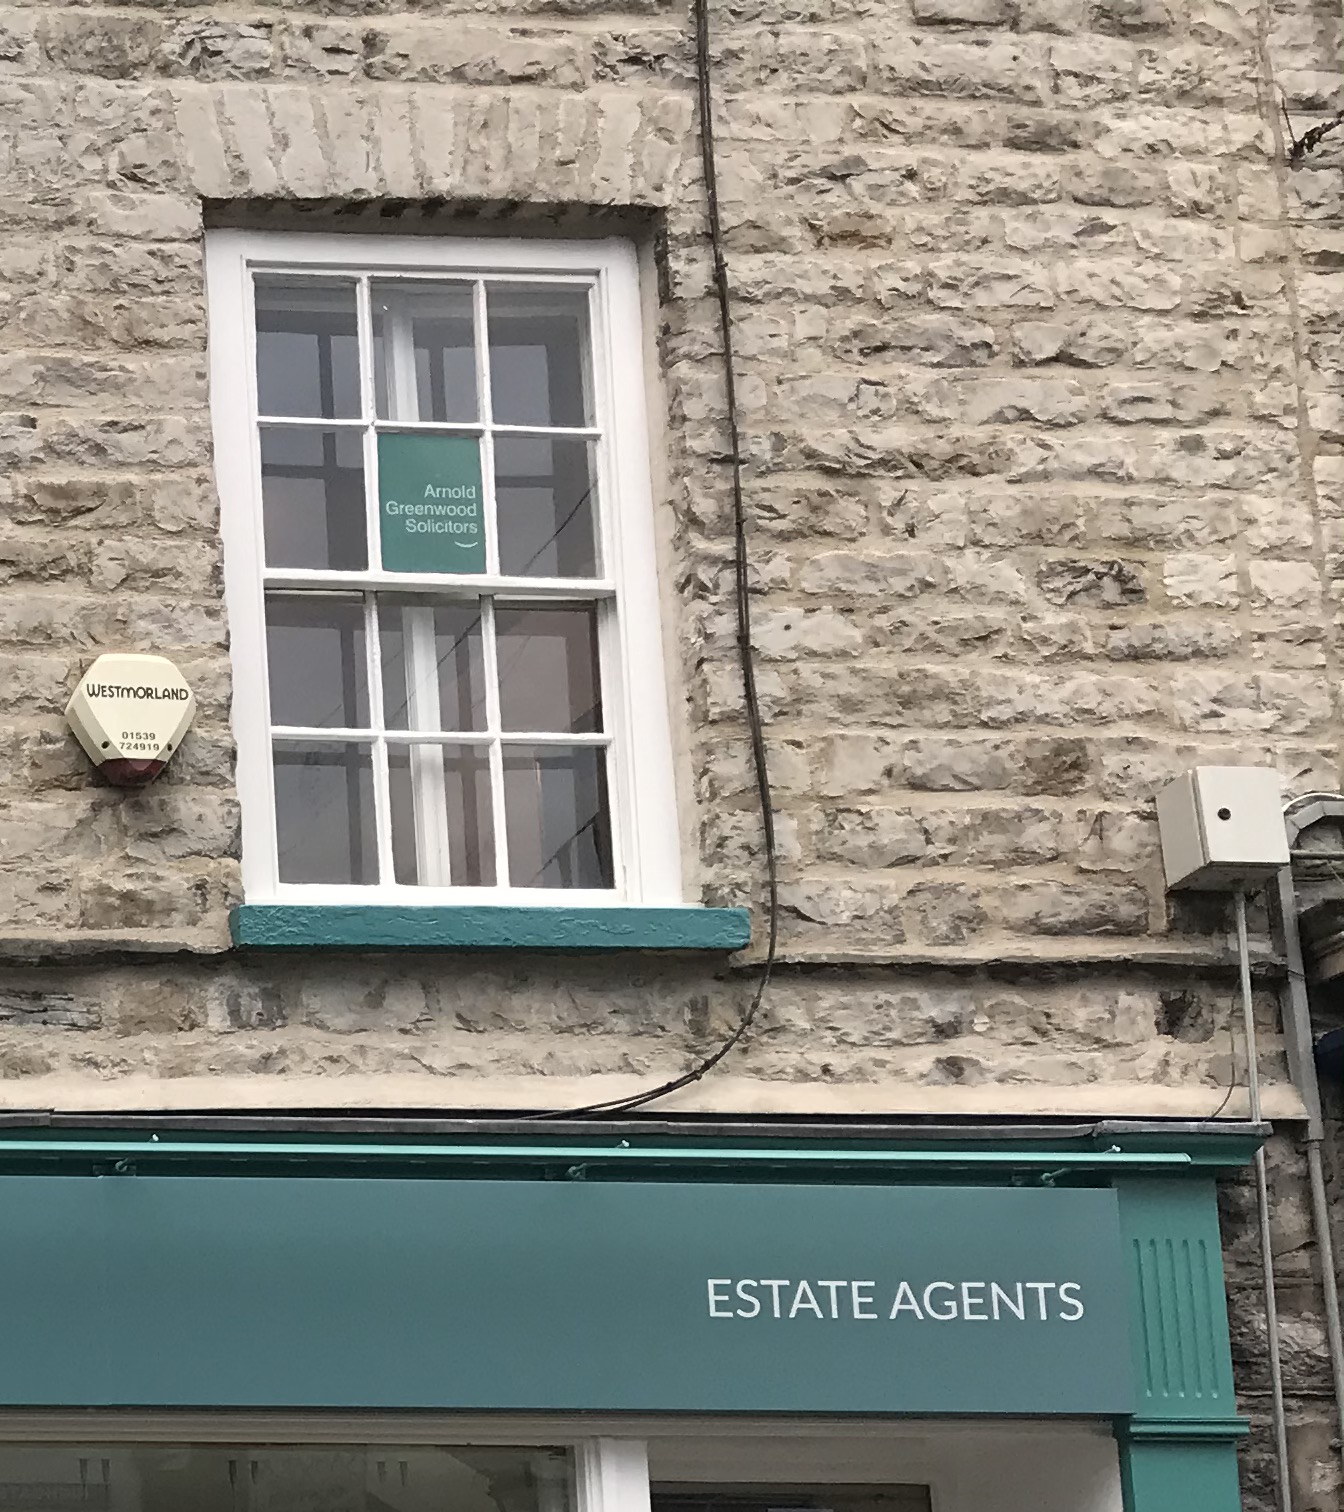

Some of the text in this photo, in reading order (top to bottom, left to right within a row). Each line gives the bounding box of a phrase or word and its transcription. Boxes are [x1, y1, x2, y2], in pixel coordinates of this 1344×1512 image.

[424, 484, 476, 499] Arnold
[385, 500, 477, 517] Greenwood
[405, 518, 478, 534] Solicitors
[86, 683, 189, 701] WESTMORLAND
[122, 731, 156, 741] 01539
[119, 742, 160, 752] 724919
[707, 1278, 1085, 1321] ESTATE AGENTS
